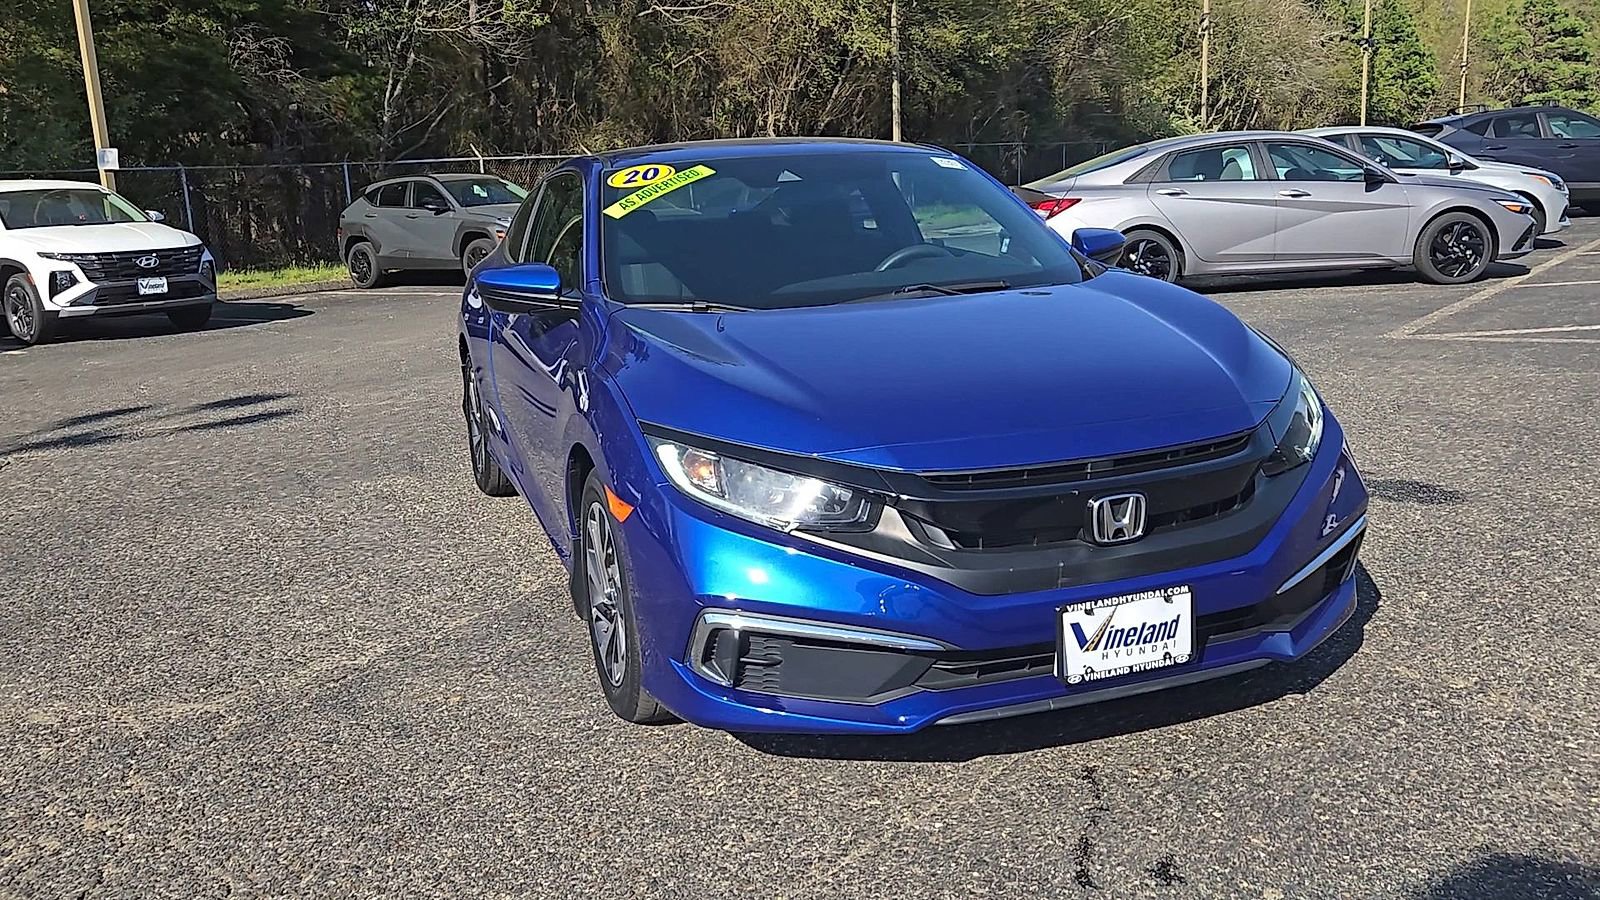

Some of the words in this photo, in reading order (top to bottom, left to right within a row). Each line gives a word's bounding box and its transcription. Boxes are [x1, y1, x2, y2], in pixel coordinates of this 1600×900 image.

[622, 167, 660, 185] 20
[619, 198, 637, 211] AS
[636, 169, 700, 202] ADVERTISED
[1066, 585, 1189, 612] VINELANDHYUNDAI.COM
[1070, 606, 1181, 653] Vineland
[1102, 640, 1177, 660] HYUNDAI
[1083, 667, 1130, 682] VINELAND
[1132, 657, 1175, 672] HYUNDAI
